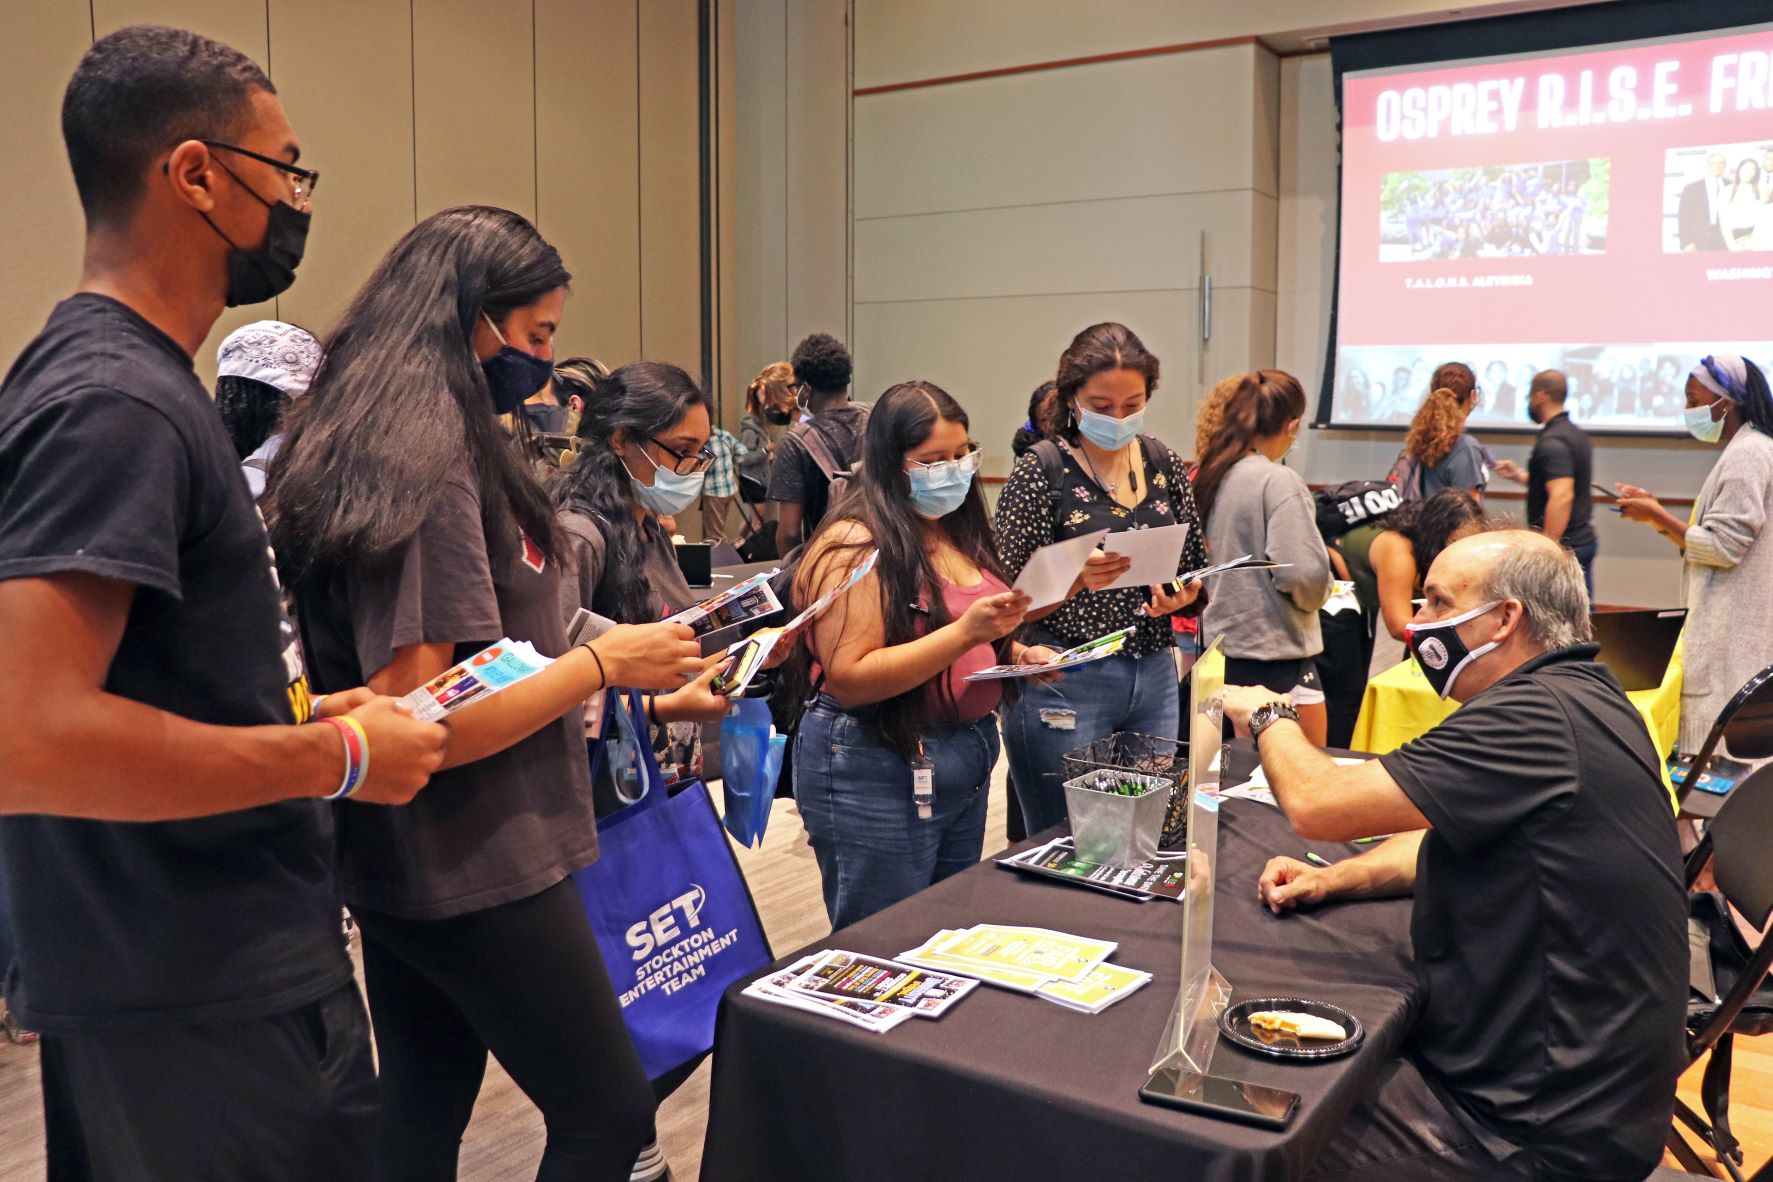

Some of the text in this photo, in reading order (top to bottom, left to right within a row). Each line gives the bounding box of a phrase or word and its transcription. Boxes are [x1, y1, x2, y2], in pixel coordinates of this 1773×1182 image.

[1376, 49, 1773, 143] OSPREY R.I.S.E. FR
[625, 884, 706, 961] SET
[635, 927, 715, 981] STOCKTON
[618, 928, 738, 1009] ENTERTAINMENT
[660, 964, 706, 996] TEAM
